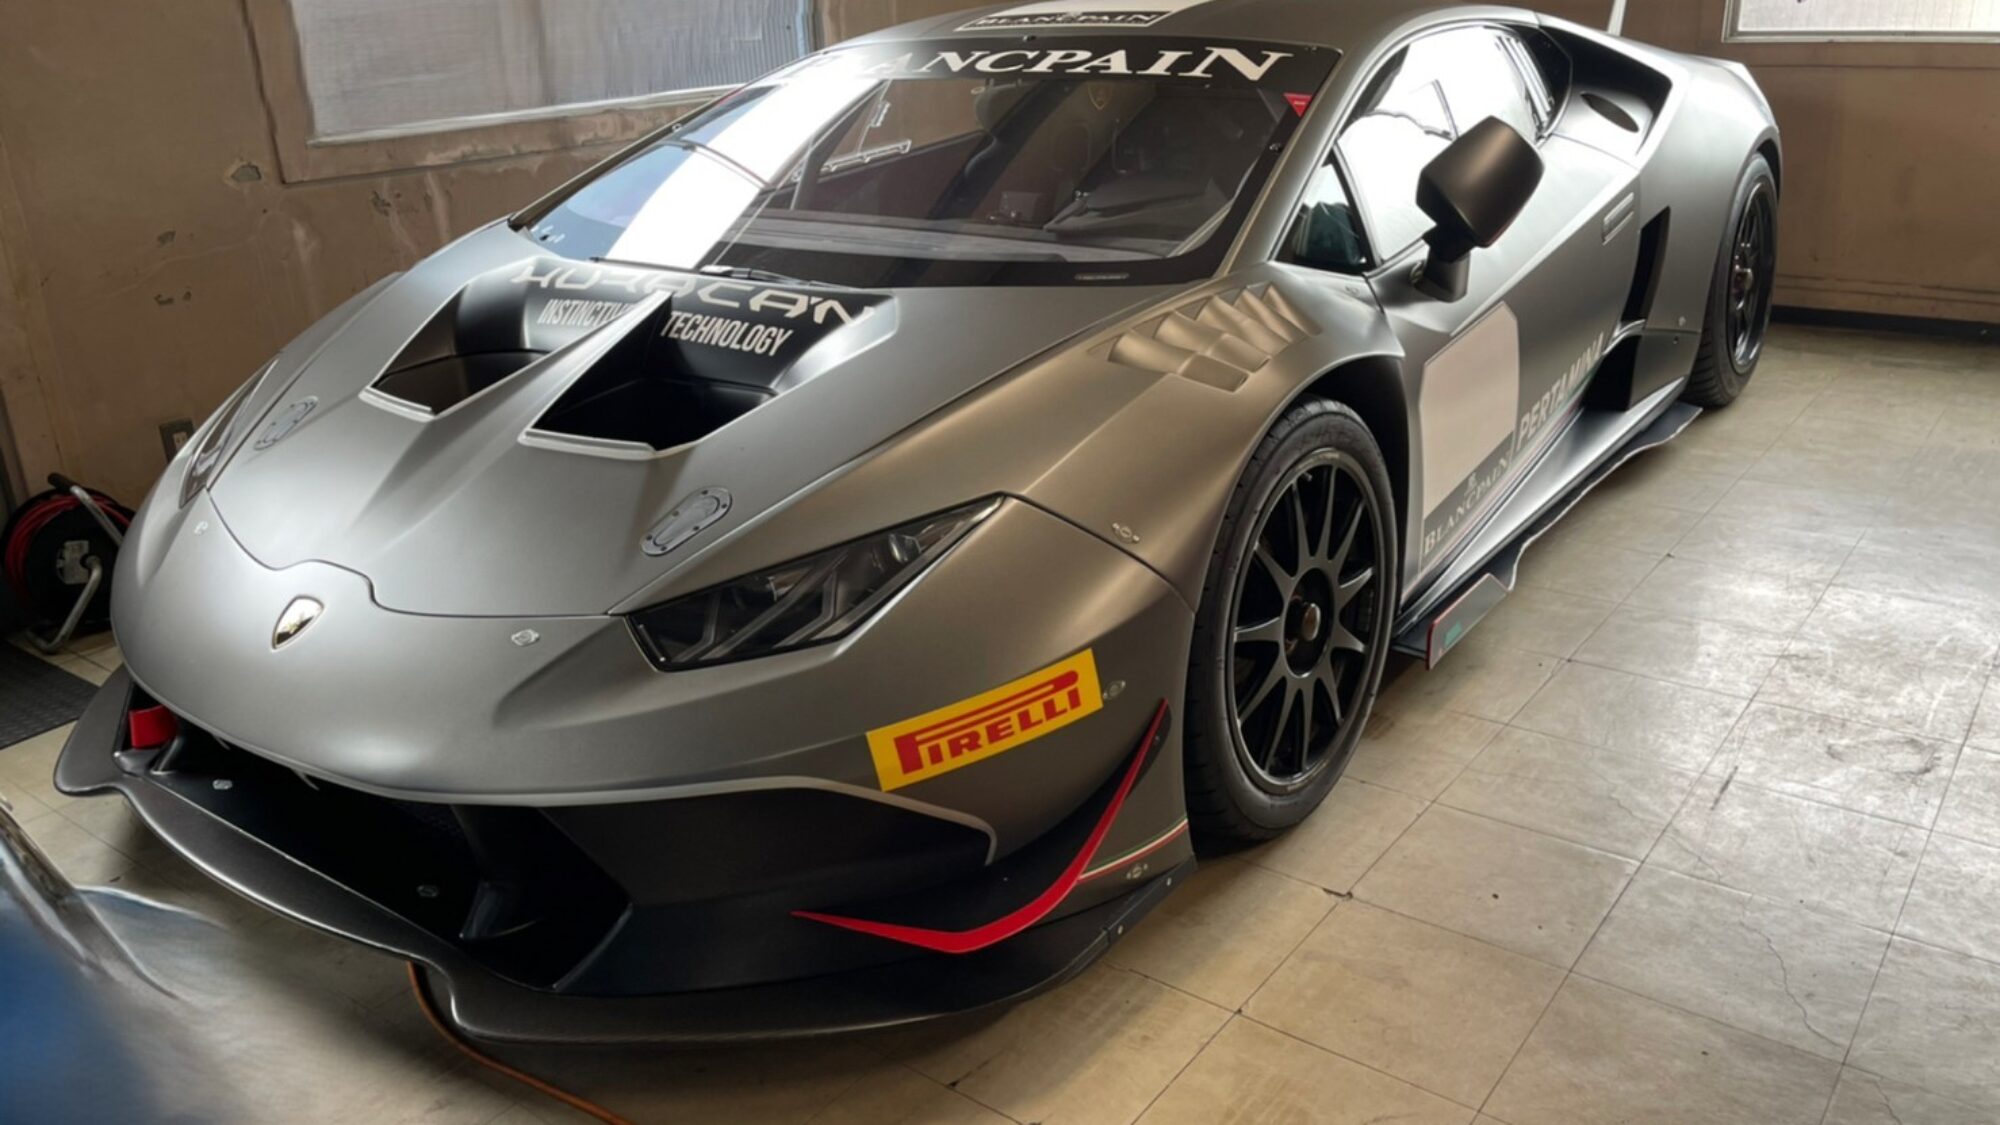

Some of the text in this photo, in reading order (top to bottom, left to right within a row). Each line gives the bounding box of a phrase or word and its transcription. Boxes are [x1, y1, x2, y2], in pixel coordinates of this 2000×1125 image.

[659, 310, 794, 358] TECHNOLOGY
[1424, 450, 1512, 555] BLANCPAIN
[893, 669, 1082, 776] PIRELLI
